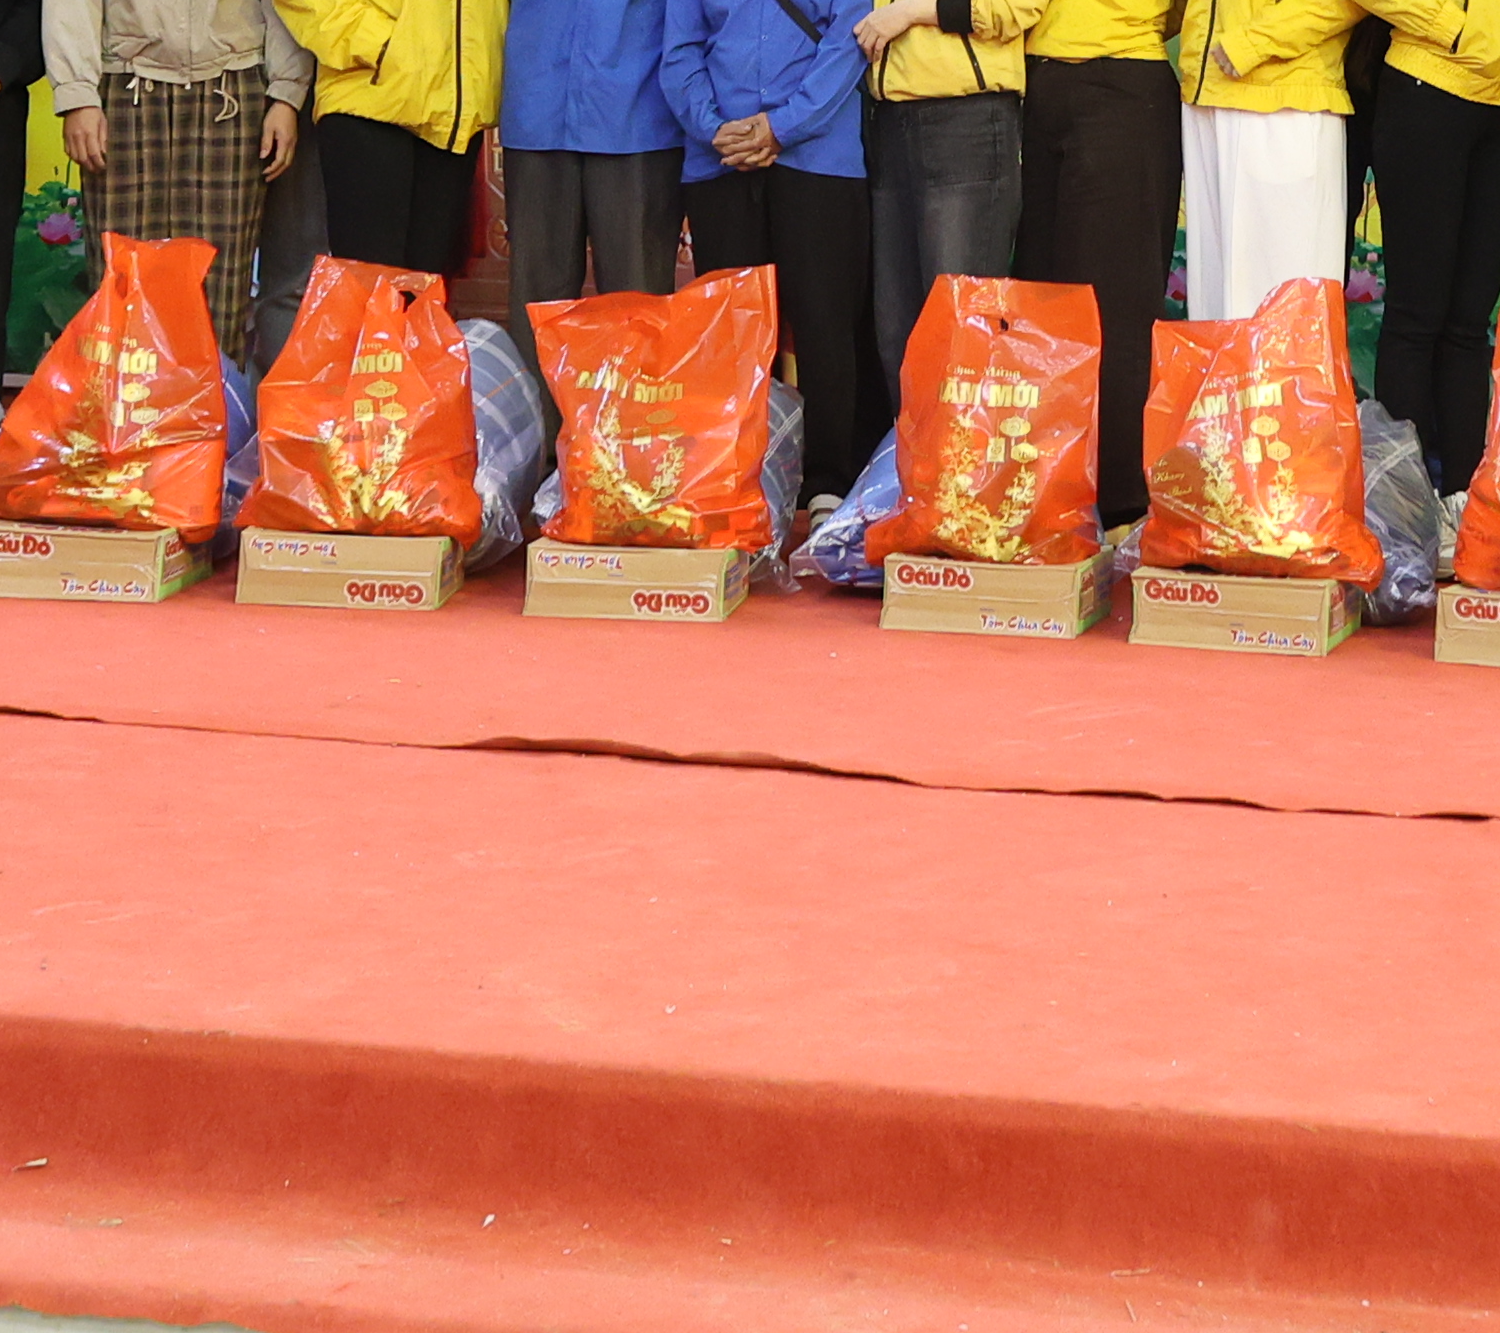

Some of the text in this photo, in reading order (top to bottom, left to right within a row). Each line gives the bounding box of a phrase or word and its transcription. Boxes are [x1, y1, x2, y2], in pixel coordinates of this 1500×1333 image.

[352, 347, 404, 375] MỚI
[987, 379, 1040, 409] MỚI
[22, 534, 51, 556] Đỏ
[897, 564, 971, 590] Gấu Đỏ
[347, 582, 424, 604] Gấu Đỏ
[633, 592, 709, 616] Gấu Đỏ
[1145, 579, 1219, 605] Gấu Đỏ
[1455, 596, 1498, 620] Gấu
